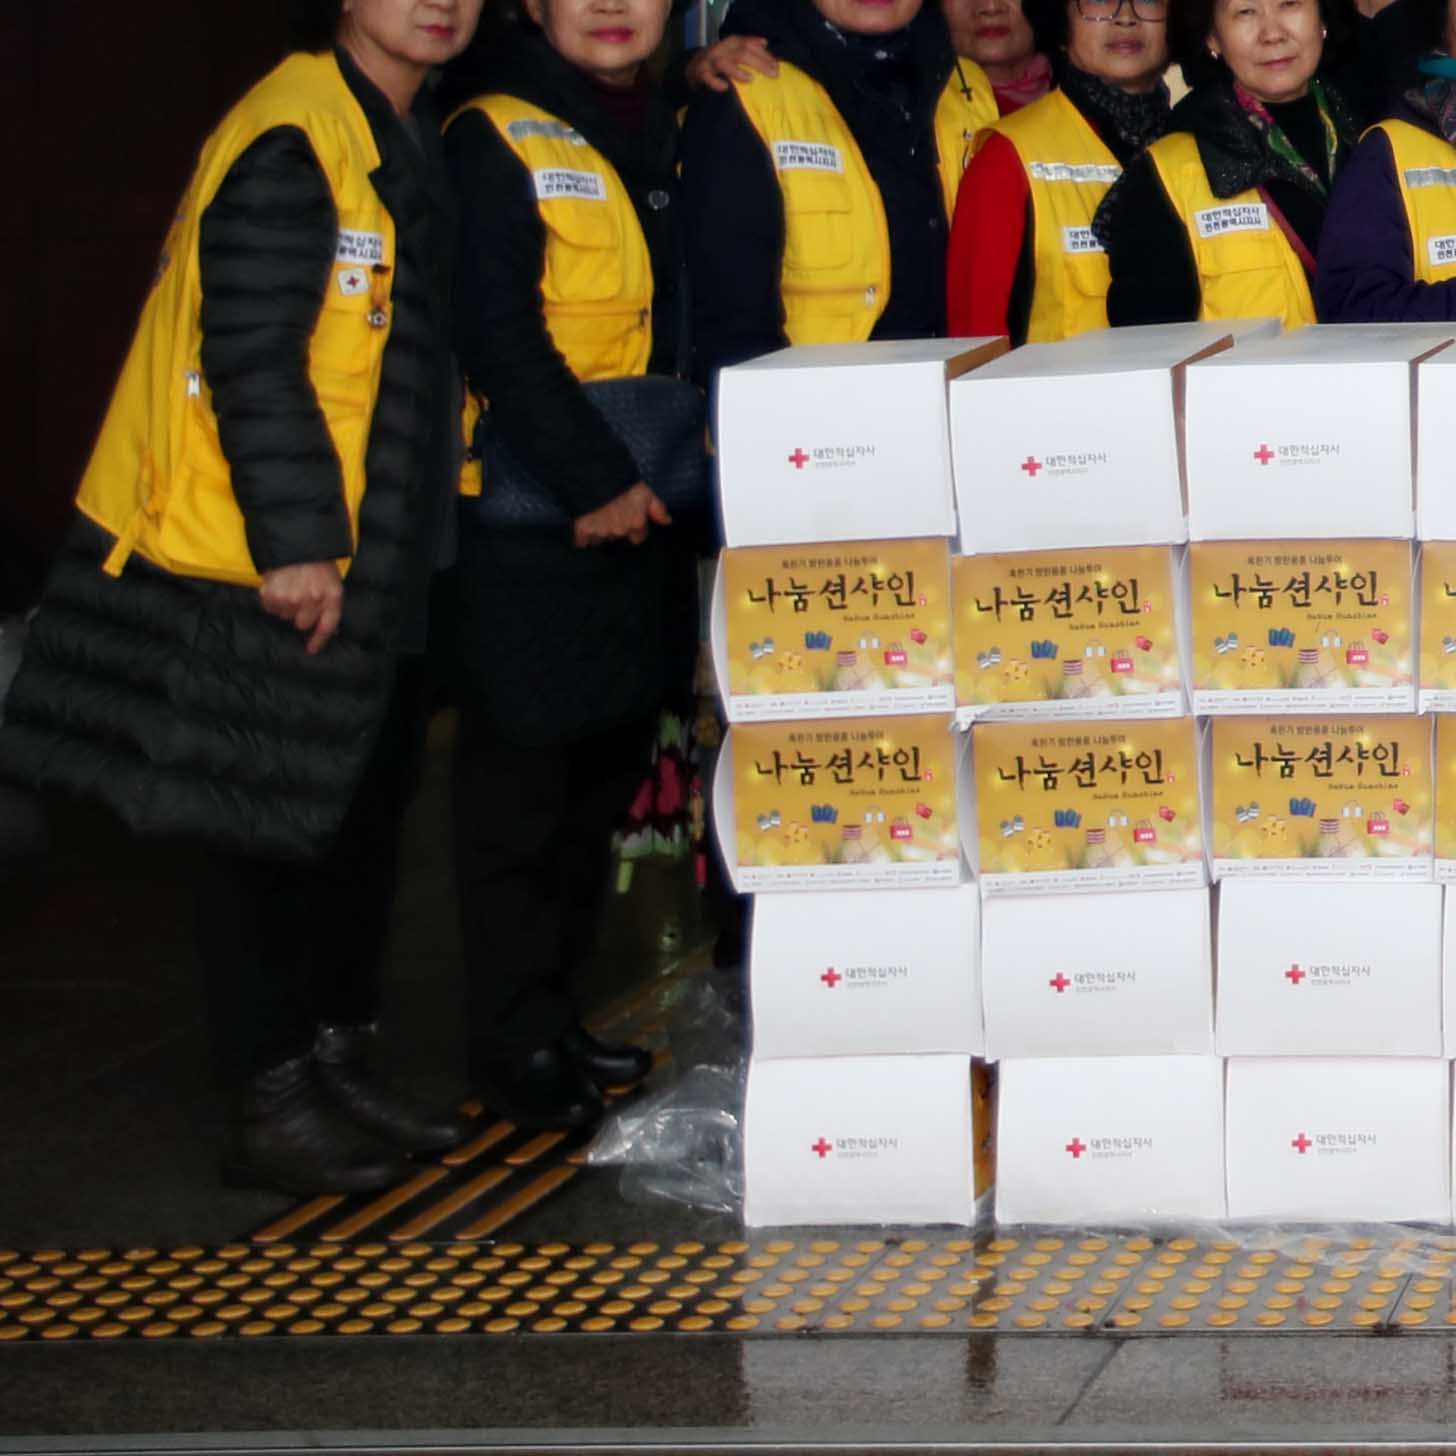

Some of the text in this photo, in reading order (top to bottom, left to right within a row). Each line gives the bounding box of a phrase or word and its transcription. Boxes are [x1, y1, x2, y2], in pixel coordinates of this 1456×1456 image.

[813, 445, 876, 459] 대한적십자사
[1278, 443, 1340, 456] 대한적십자사
[1045, 453, 1107, 467] 대한적십자사
[747, 571, 915, 613] 나눔션샤인
[1213, 571, 1378, 609] 나눔션샤인
[974, 578, 1140, 622] 나눔션샤인
[754, 746, 921, 786] 나눔션샤인
[1235, 741, 1399, 779] 나눔션샤인
[997, 749, 1164, 791] 나눔션샤인
[845, 966, 908, 979] 대한적십자사
[1074, 971, 1136, 984] 대한적십자사
[1309, 965, 1371, 977] 대한적십자사
[836, 1137, 898, 1150] 대한적십자사
[1090, 1137, 1153, 1150] 대한적십자사
[1315, 1133, 1377, 1145] 대한적십자사
